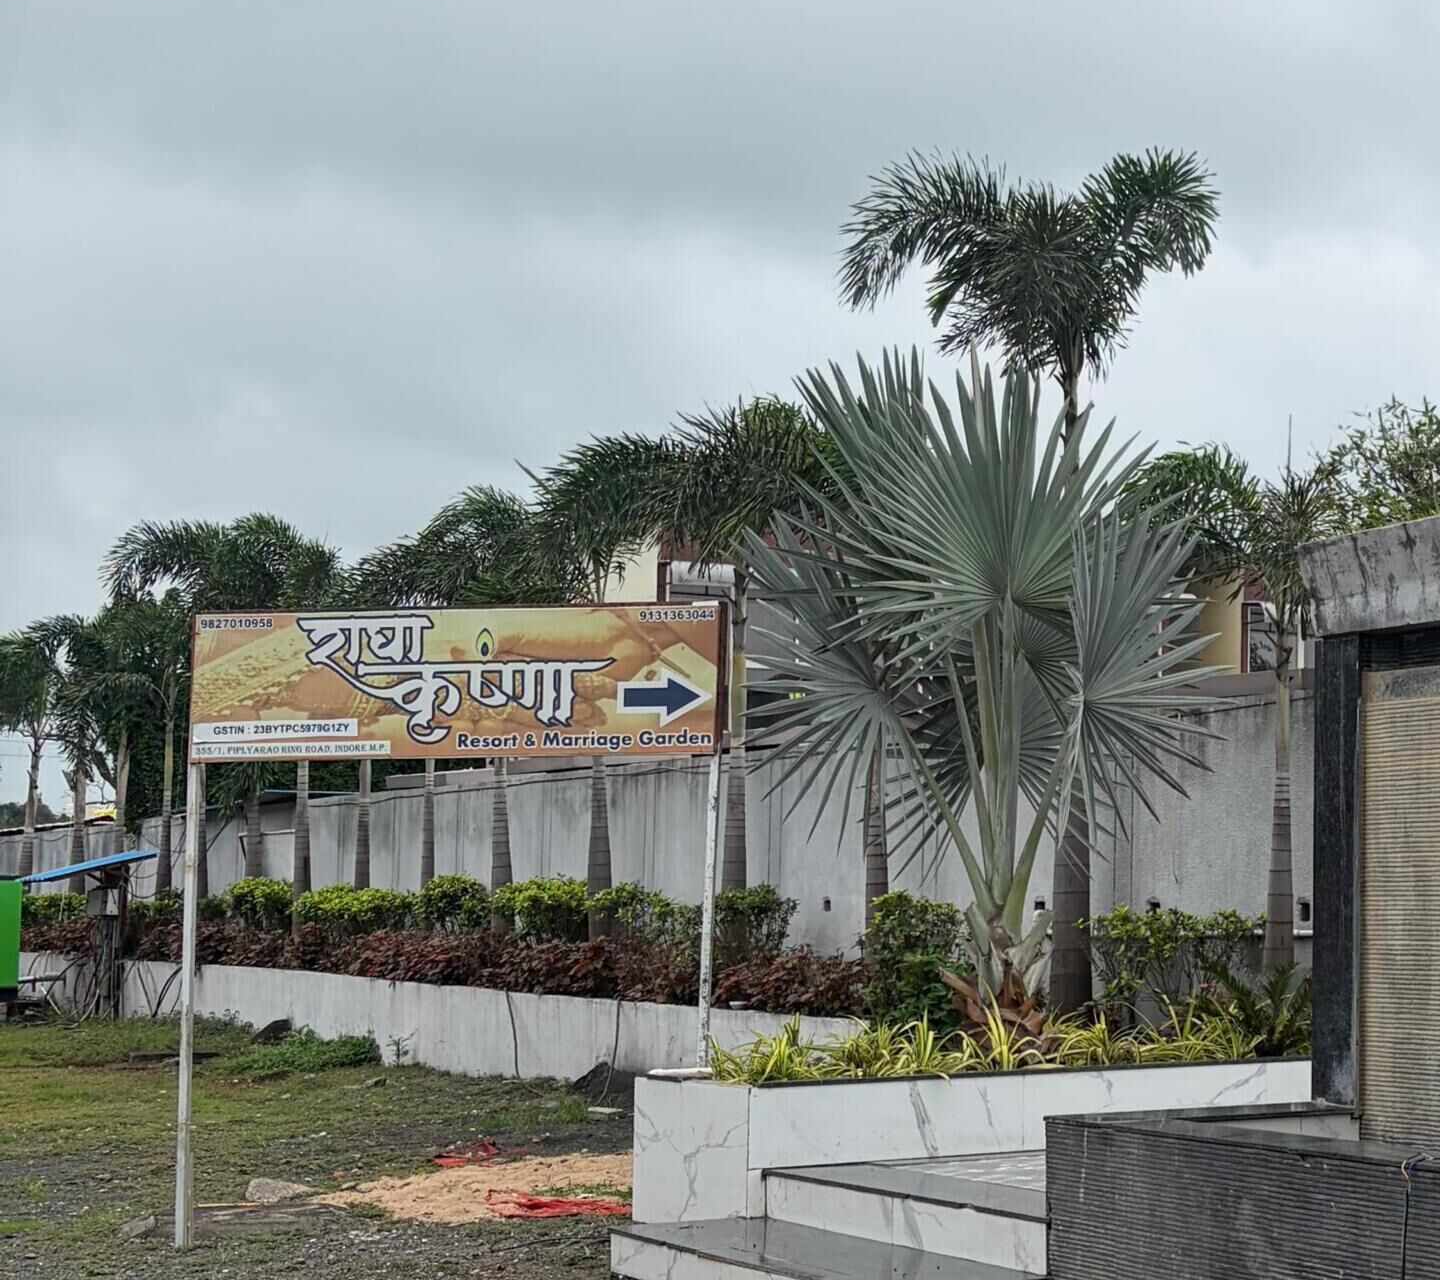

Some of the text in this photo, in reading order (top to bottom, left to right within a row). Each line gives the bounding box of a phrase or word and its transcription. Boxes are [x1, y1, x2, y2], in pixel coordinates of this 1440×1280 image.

[639, 609, 714, 621] 9131363044
[201, 618, 273, 629] 9827010958
[356, 657, 617, 745] कृष्णा
[213, 726, 245, 736] GSTIN
[456, 728, 712, 751] Resort & Marriage Garden
[281, 745, 303, 754] RING
[334, 743, 367, 753] INDORE
